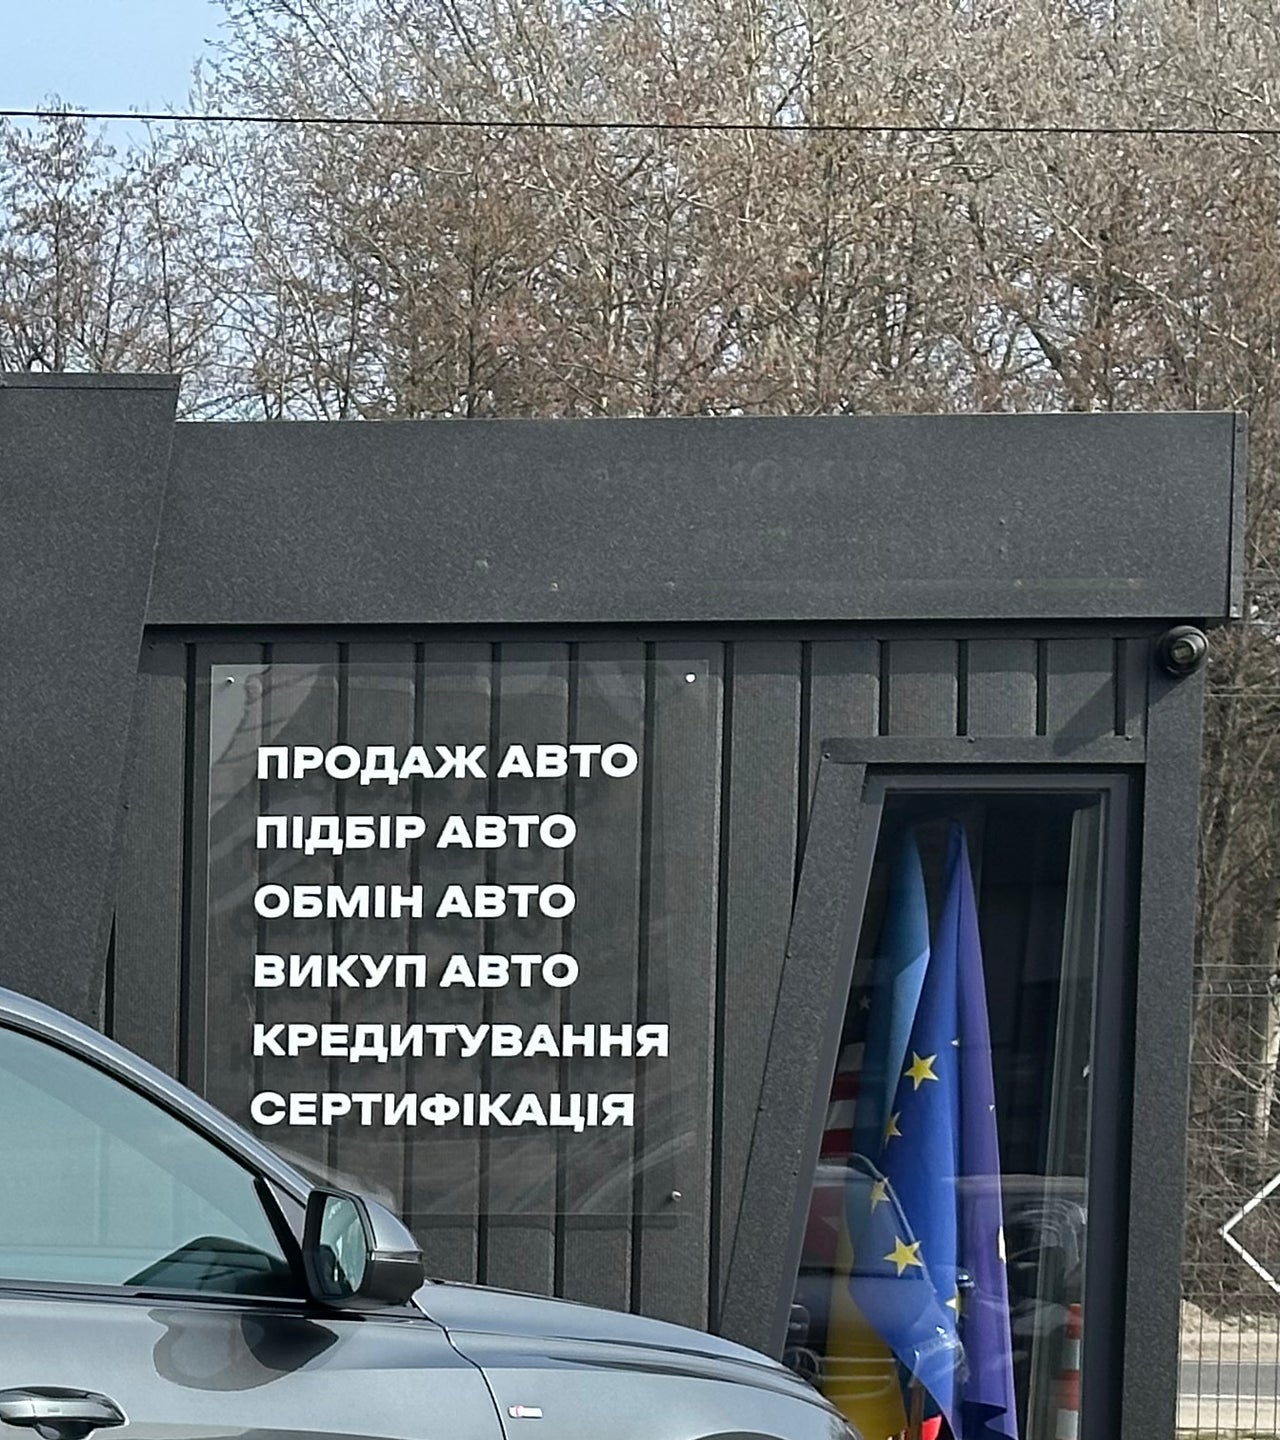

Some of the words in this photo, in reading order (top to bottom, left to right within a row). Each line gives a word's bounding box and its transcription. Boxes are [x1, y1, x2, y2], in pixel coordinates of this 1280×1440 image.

[256, 744, 487, 787] ПРОДАЖ
[497, 743, 639, 780] АВТО
[255, 814, 427, 857] ПІДБІР
[436, 813, 578, 850] АВТО
[253, 884, 424, 919] ОБМІН
[435, 883, 577, 919] АВТО
[253, 953, 428, 989] ВИКУП
[439, 953, 580, 989] АВТО
[252, 1023, 670, 1064] КРЕДИТУВАННЯ
[249, 1091, 636, 1134] СЕРТИФІКАЦІЯ
